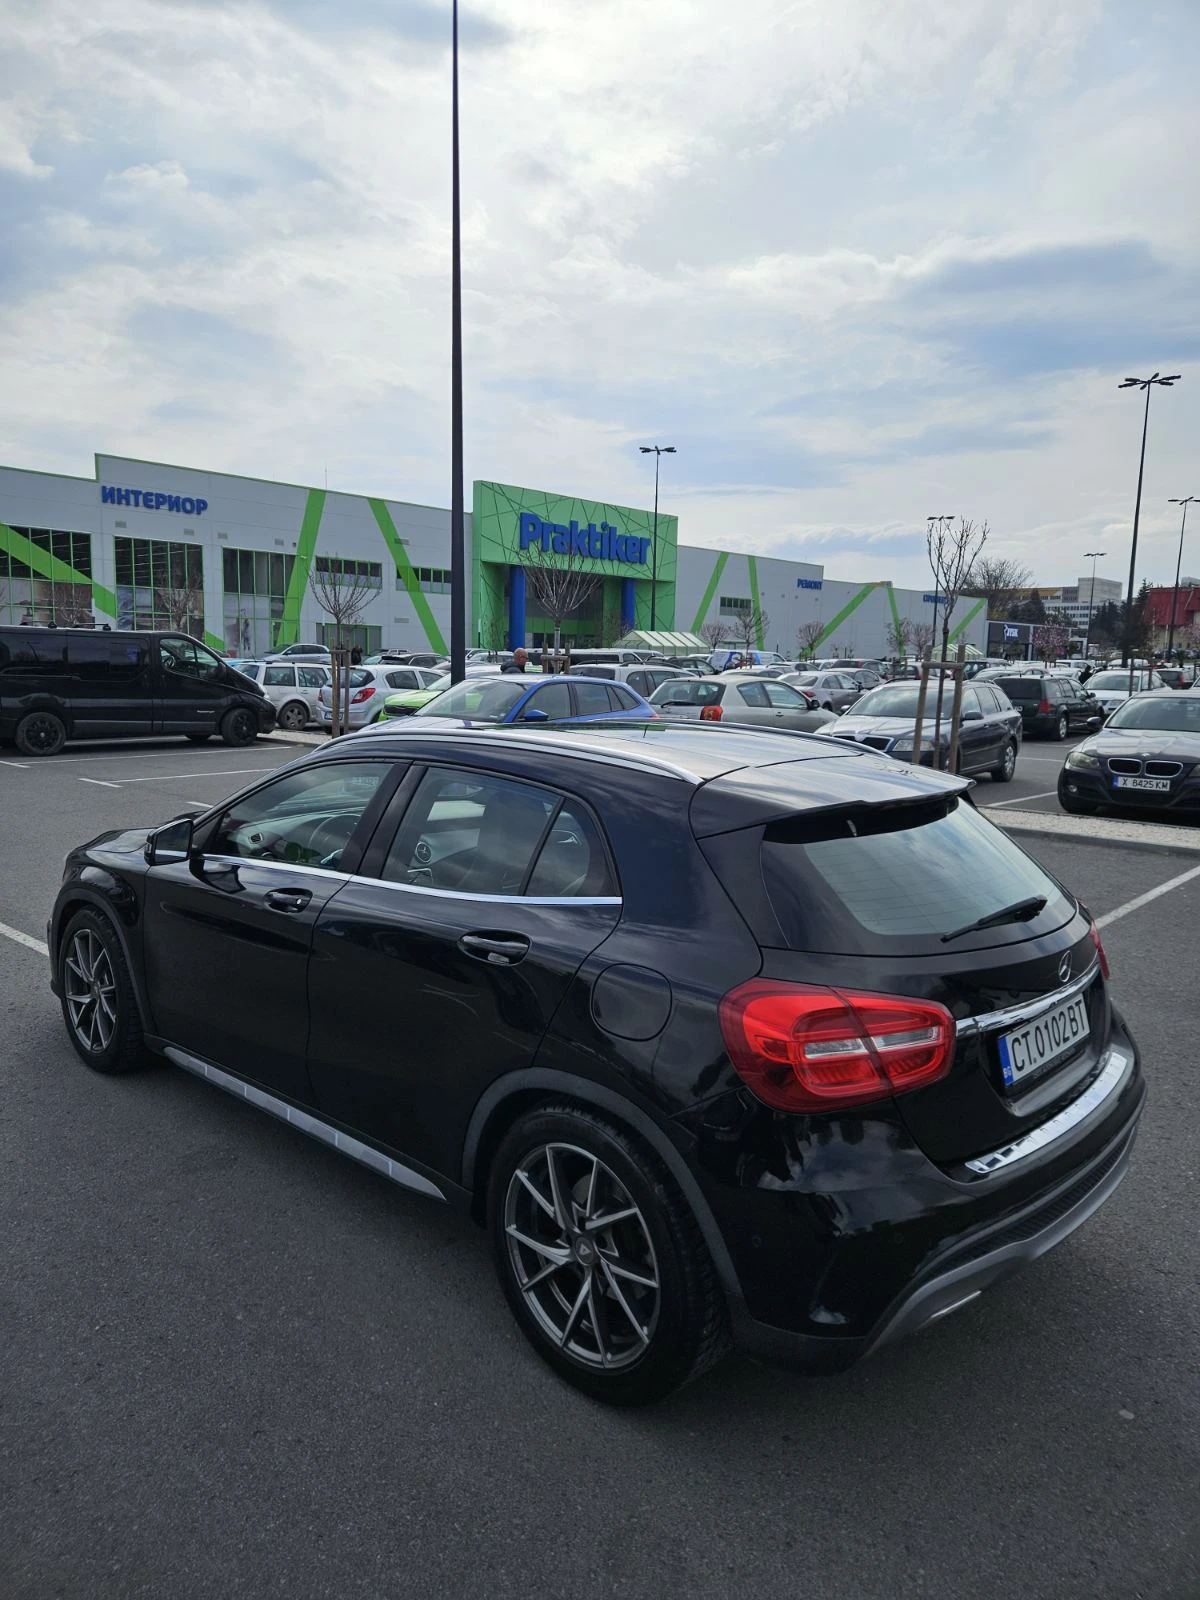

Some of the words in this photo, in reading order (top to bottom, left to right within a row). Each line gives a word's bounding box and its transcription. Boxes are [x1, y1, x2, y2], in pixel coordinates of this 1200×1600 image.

[101, 485, 208, 515] ИНТЕРИОР
[519, 511, 652, 564] Praktiker
[1122, 778, 1128, 786] X
